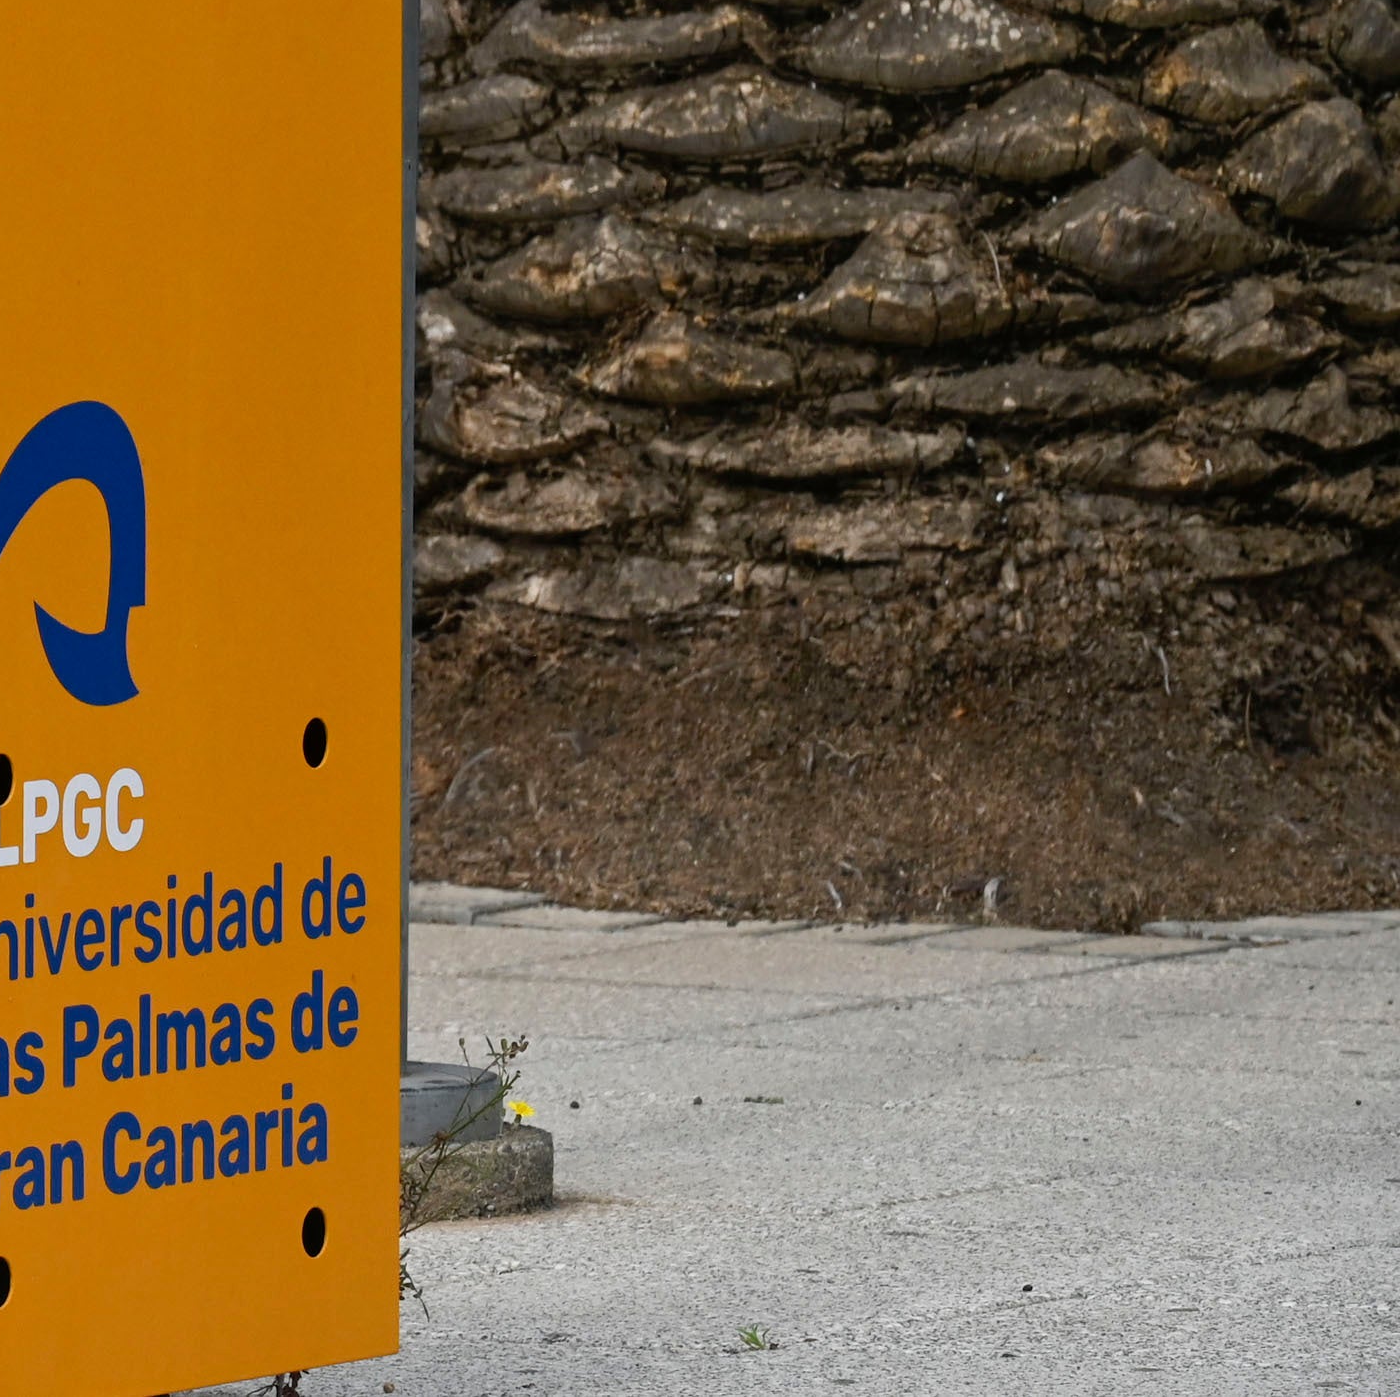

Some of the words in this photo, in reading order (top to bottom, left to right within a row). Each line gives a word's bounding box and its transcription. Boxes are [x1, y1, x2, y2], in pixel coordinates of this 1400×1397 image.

[302, 857, 367, 939] de
[64, 994, 276, 1088] Palmas
[292, 970, 359, 1053] de
[103, 1083, 329, 1195] Canaria
